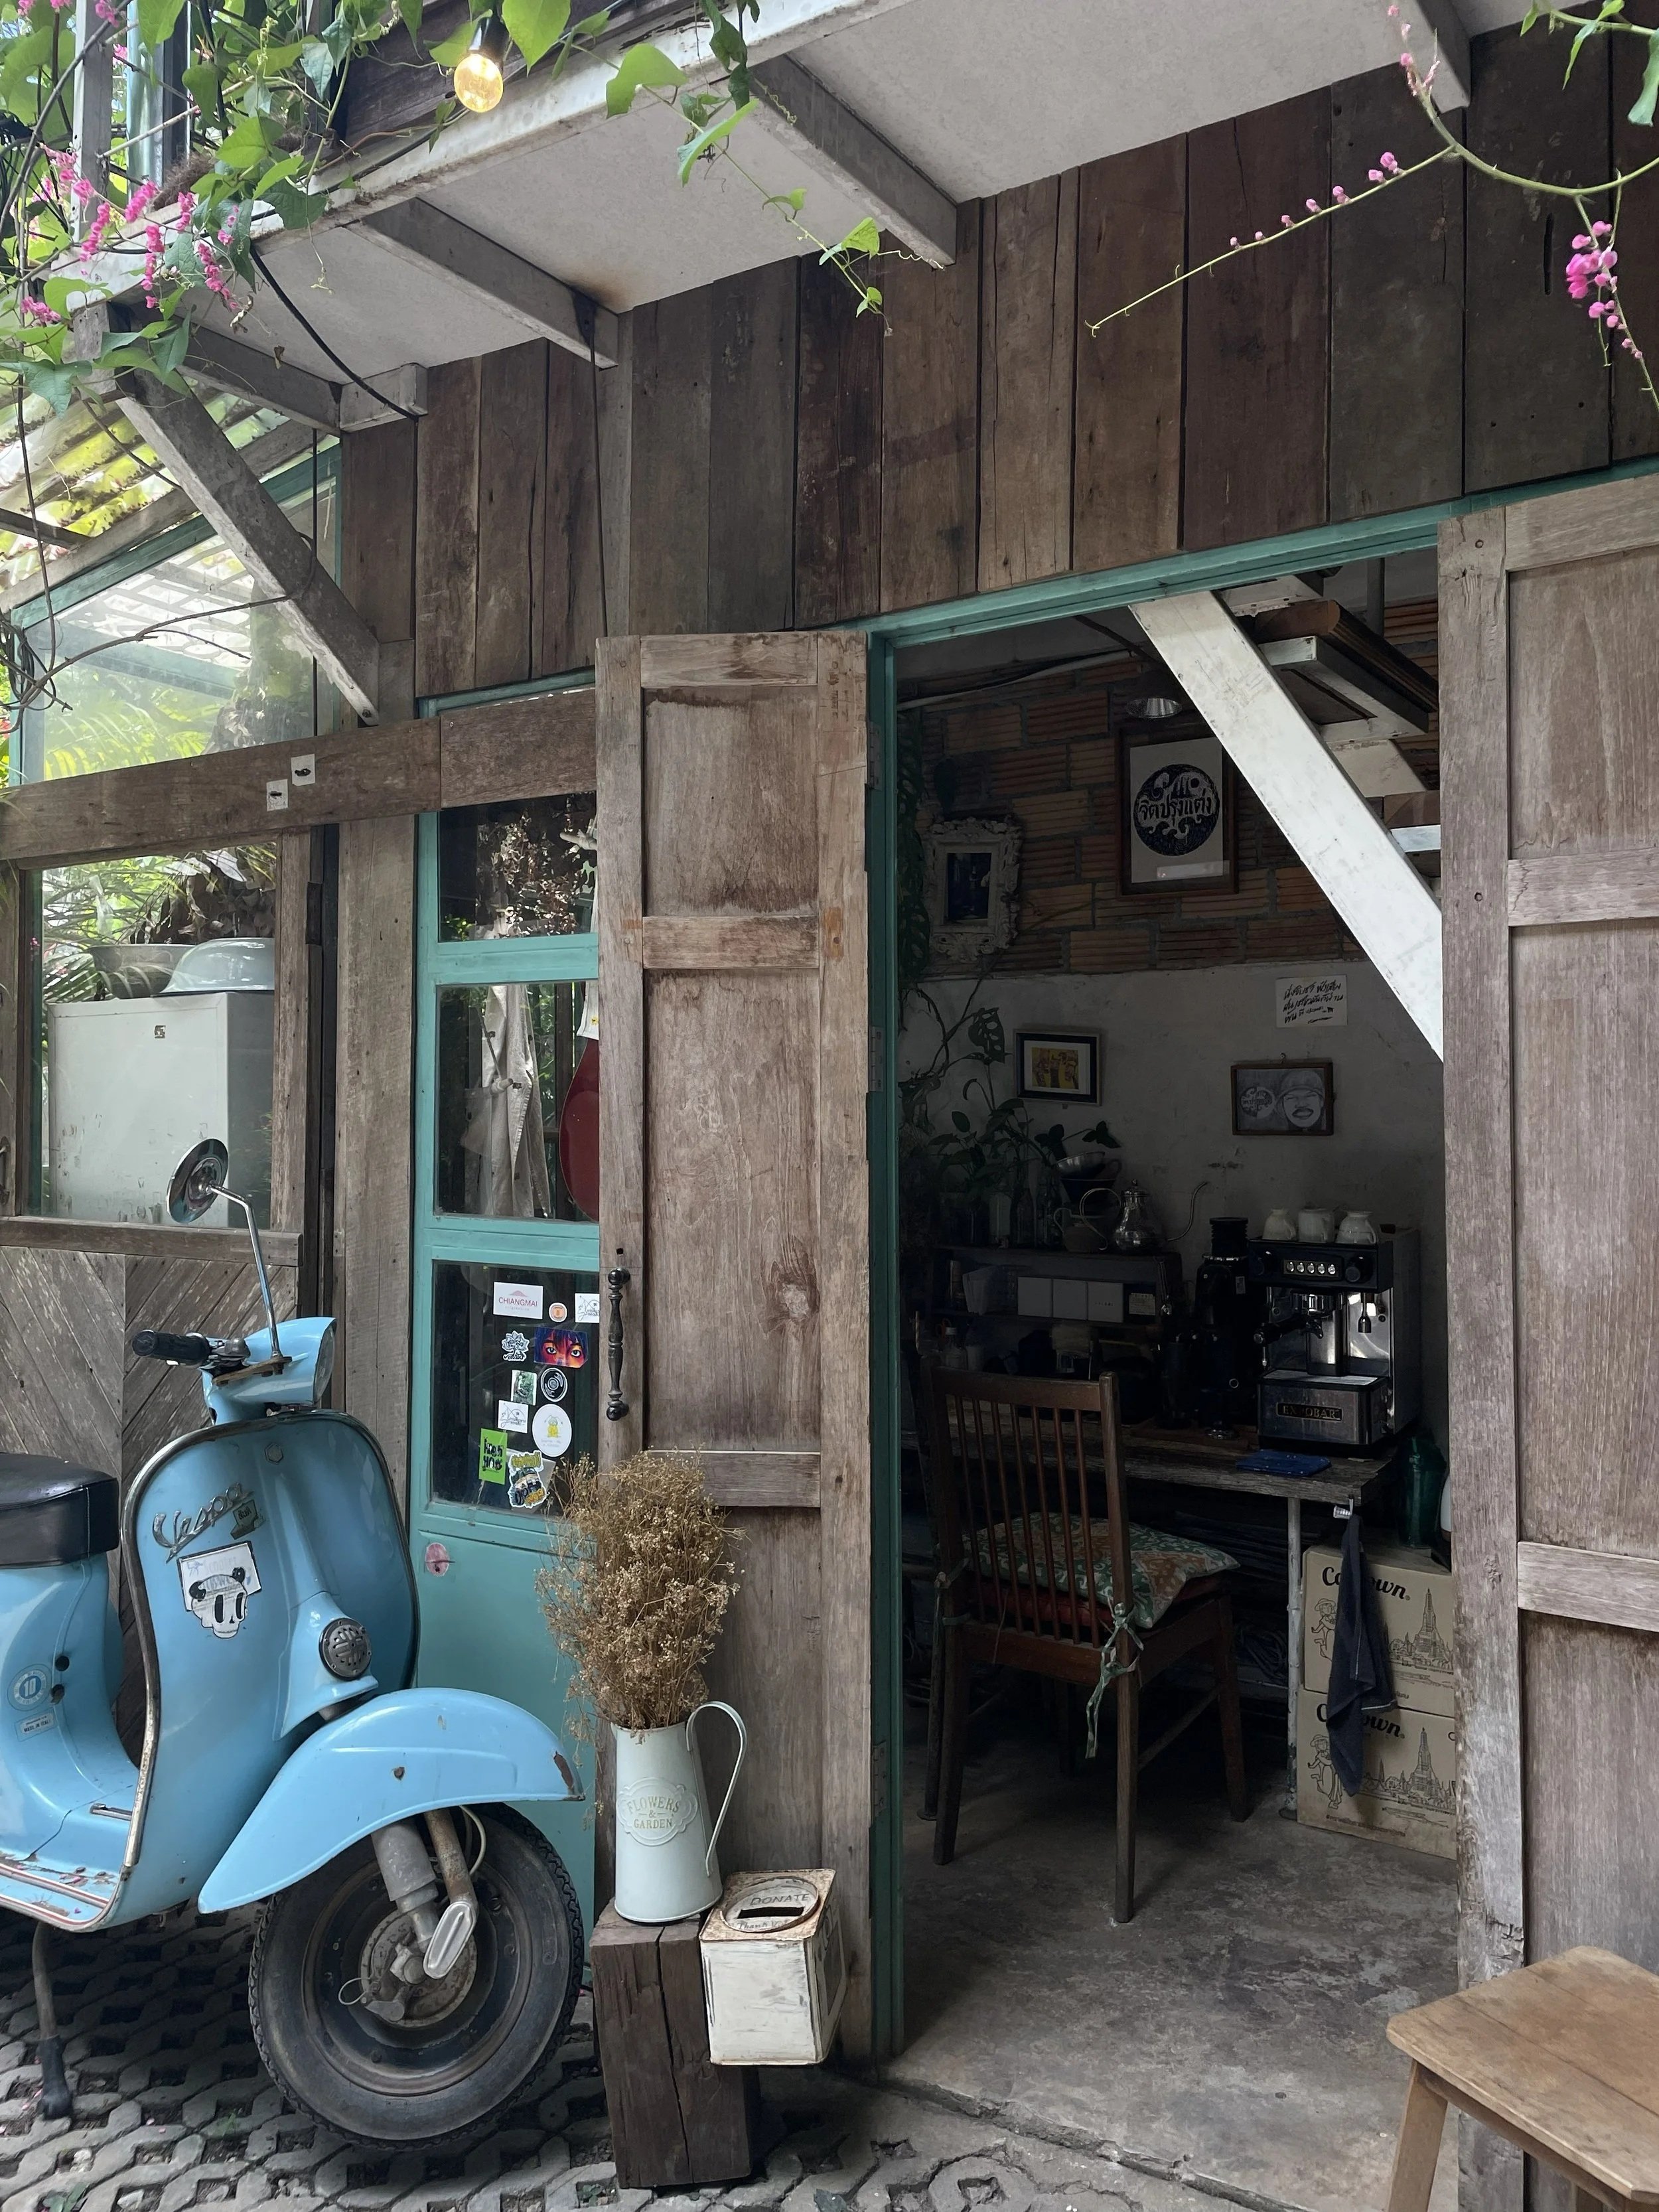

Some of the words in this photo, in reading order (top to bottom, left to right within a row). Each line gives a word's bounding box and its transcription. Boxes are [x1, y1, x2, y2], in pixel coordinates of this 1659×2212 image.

[1139, 788, 1212, 826] จิตปรุงแต่ง
[498, 1297, 538, 1307] CHIANGMAI
[1283, 1405, 1336, 1419] EXOBAR
[152, 1482, 254, 1564] Vespa
[24, 1678, 36, 1697] 10
[626, 1796, 680, 1814] FLOWERS
[648, 1809, 656, 1818] &
[634, 1818, 672, 1829] GARDEN
[750, 1893, 810, 1906] DONATE
